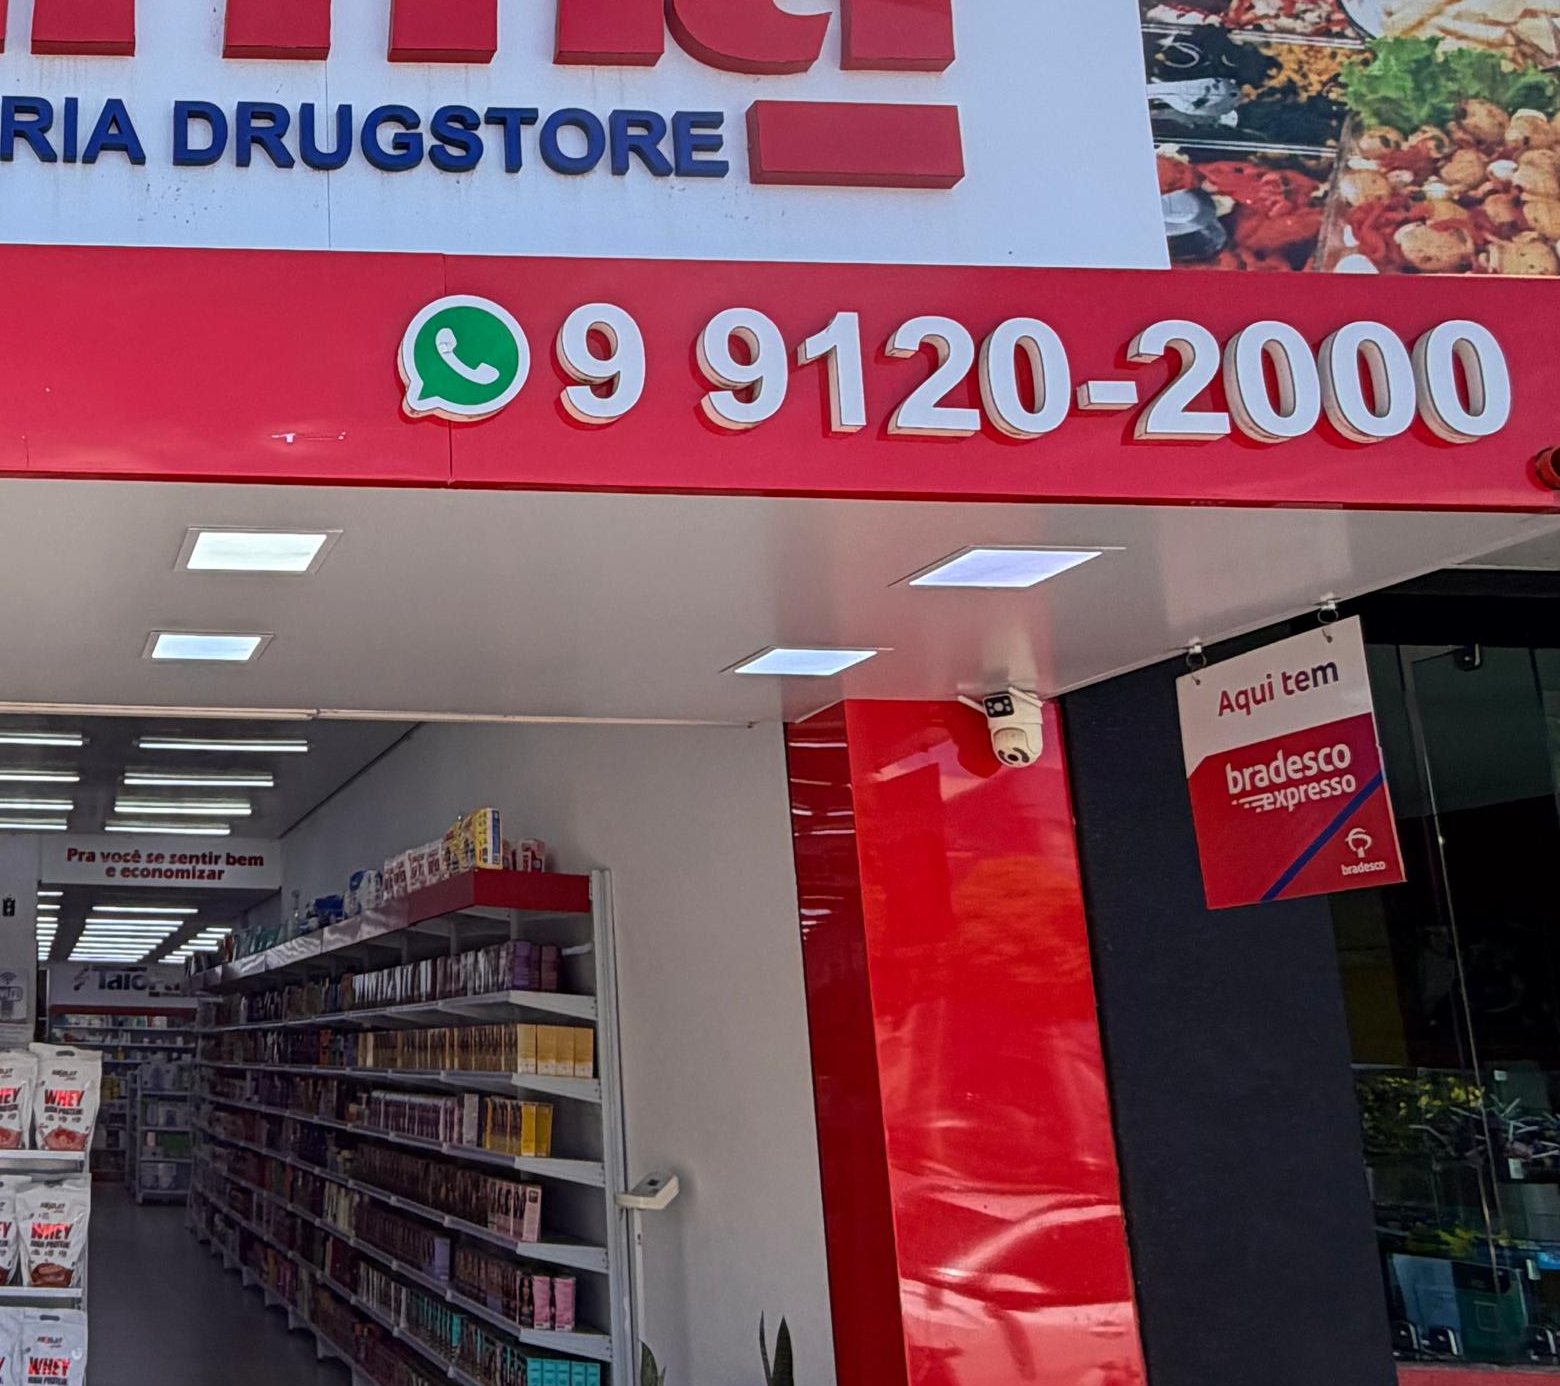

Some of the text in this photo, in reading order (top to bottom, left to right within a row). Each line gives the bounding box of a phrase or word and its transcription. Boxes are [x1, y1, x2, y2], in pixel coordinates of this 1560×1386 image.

[173, 100, 729, 178] DRUGSTORE
[555, 302, 1512, 444] 9 9120-2000
[1218, 661, 1339, 717] Aqui tem
[1225, 743, 1351, 795] bradesco
[1260, 774, 1357, 812] expresso
[67, 848, 264, 867] Pra você se sentir bem
[105, 865, 225, 881] e economizar
[1341, 860, 1386, 876] bradesco
[44, 1089, 85, 1107] WHEY
[30, 1222, 73, 1240] WHEY
[28, 1356, 71, 1376] WHEY
